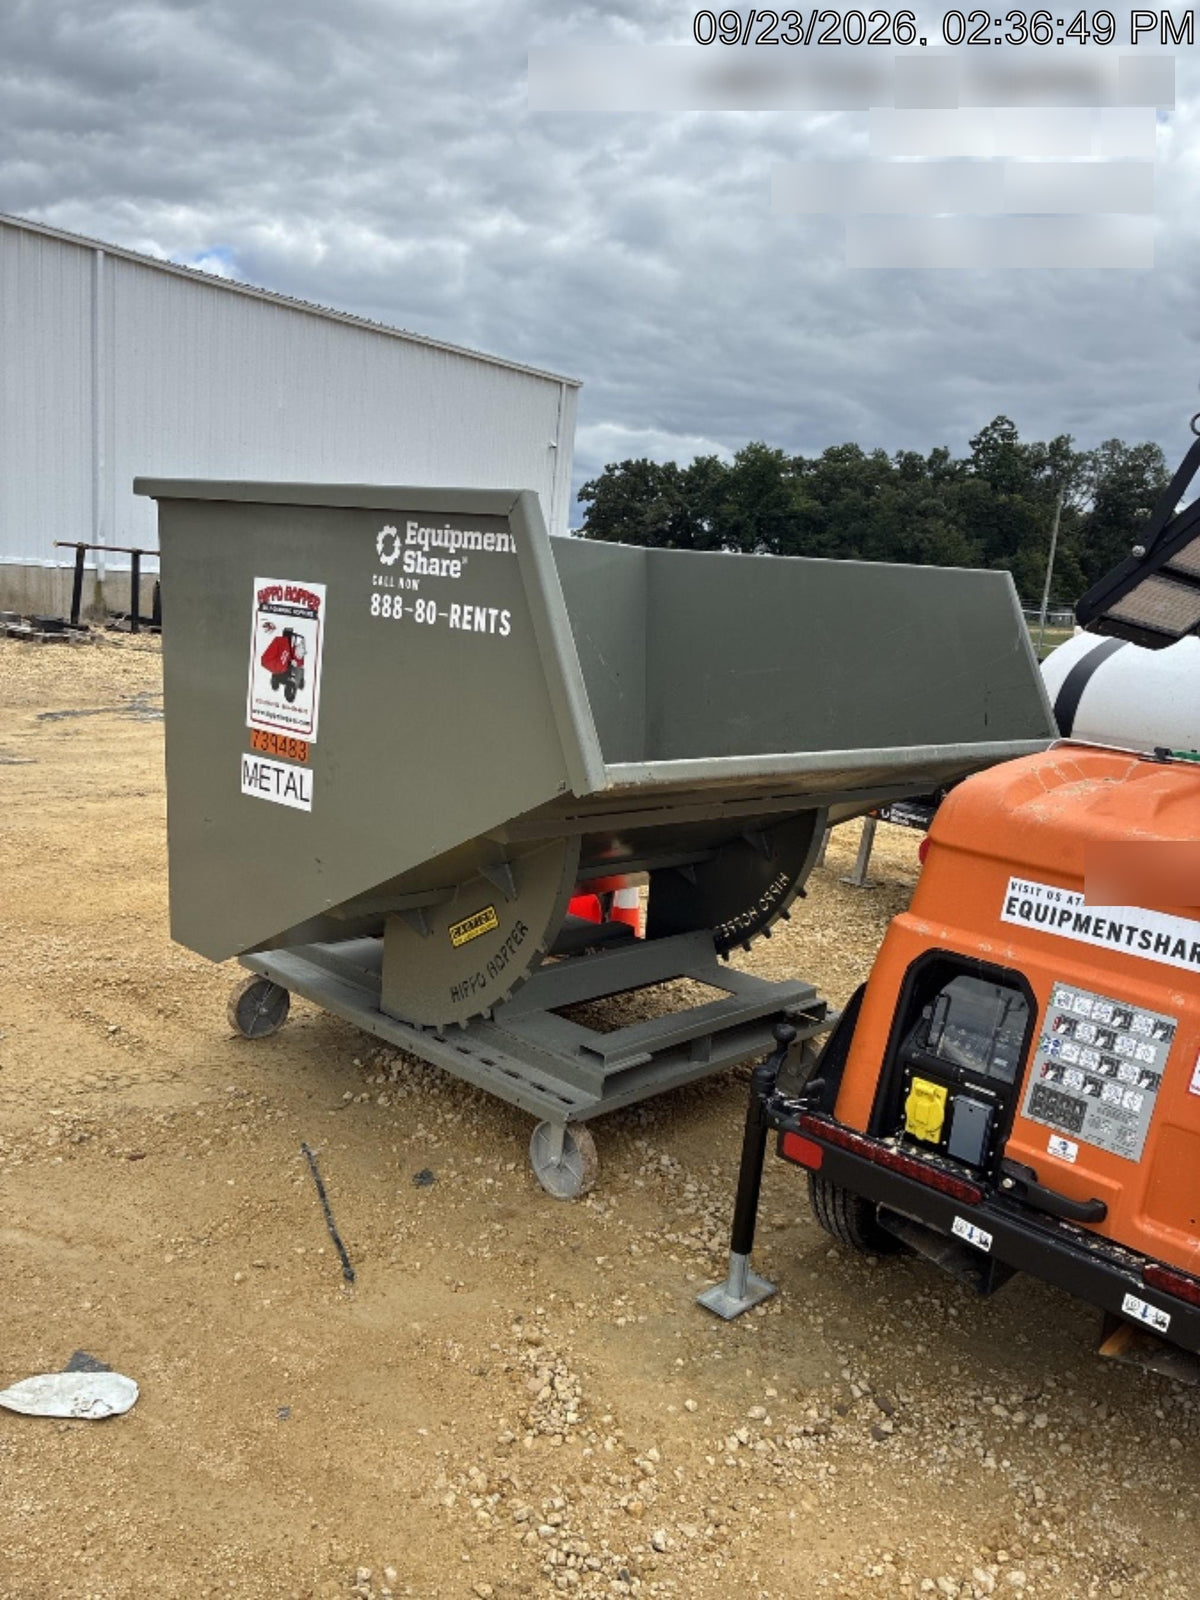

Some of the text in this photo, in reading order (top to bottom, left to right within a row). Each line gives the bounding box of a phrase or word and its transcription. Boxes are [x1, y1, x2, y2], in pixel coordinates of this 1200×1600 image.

[372, 574, 420, 591] CALL NOW
[370, 593, 512, 636] 888-80-RENTS
[252, 728, 308, 762] 739483
[243, 760, 310, 802] METAL
[1010, 881, 1043, 897] VISIT
[1046, 890, 1062, 903] US
[450, 971, 486, 1003] HIPPO
[486, 920, 529, 980] HOPPER
